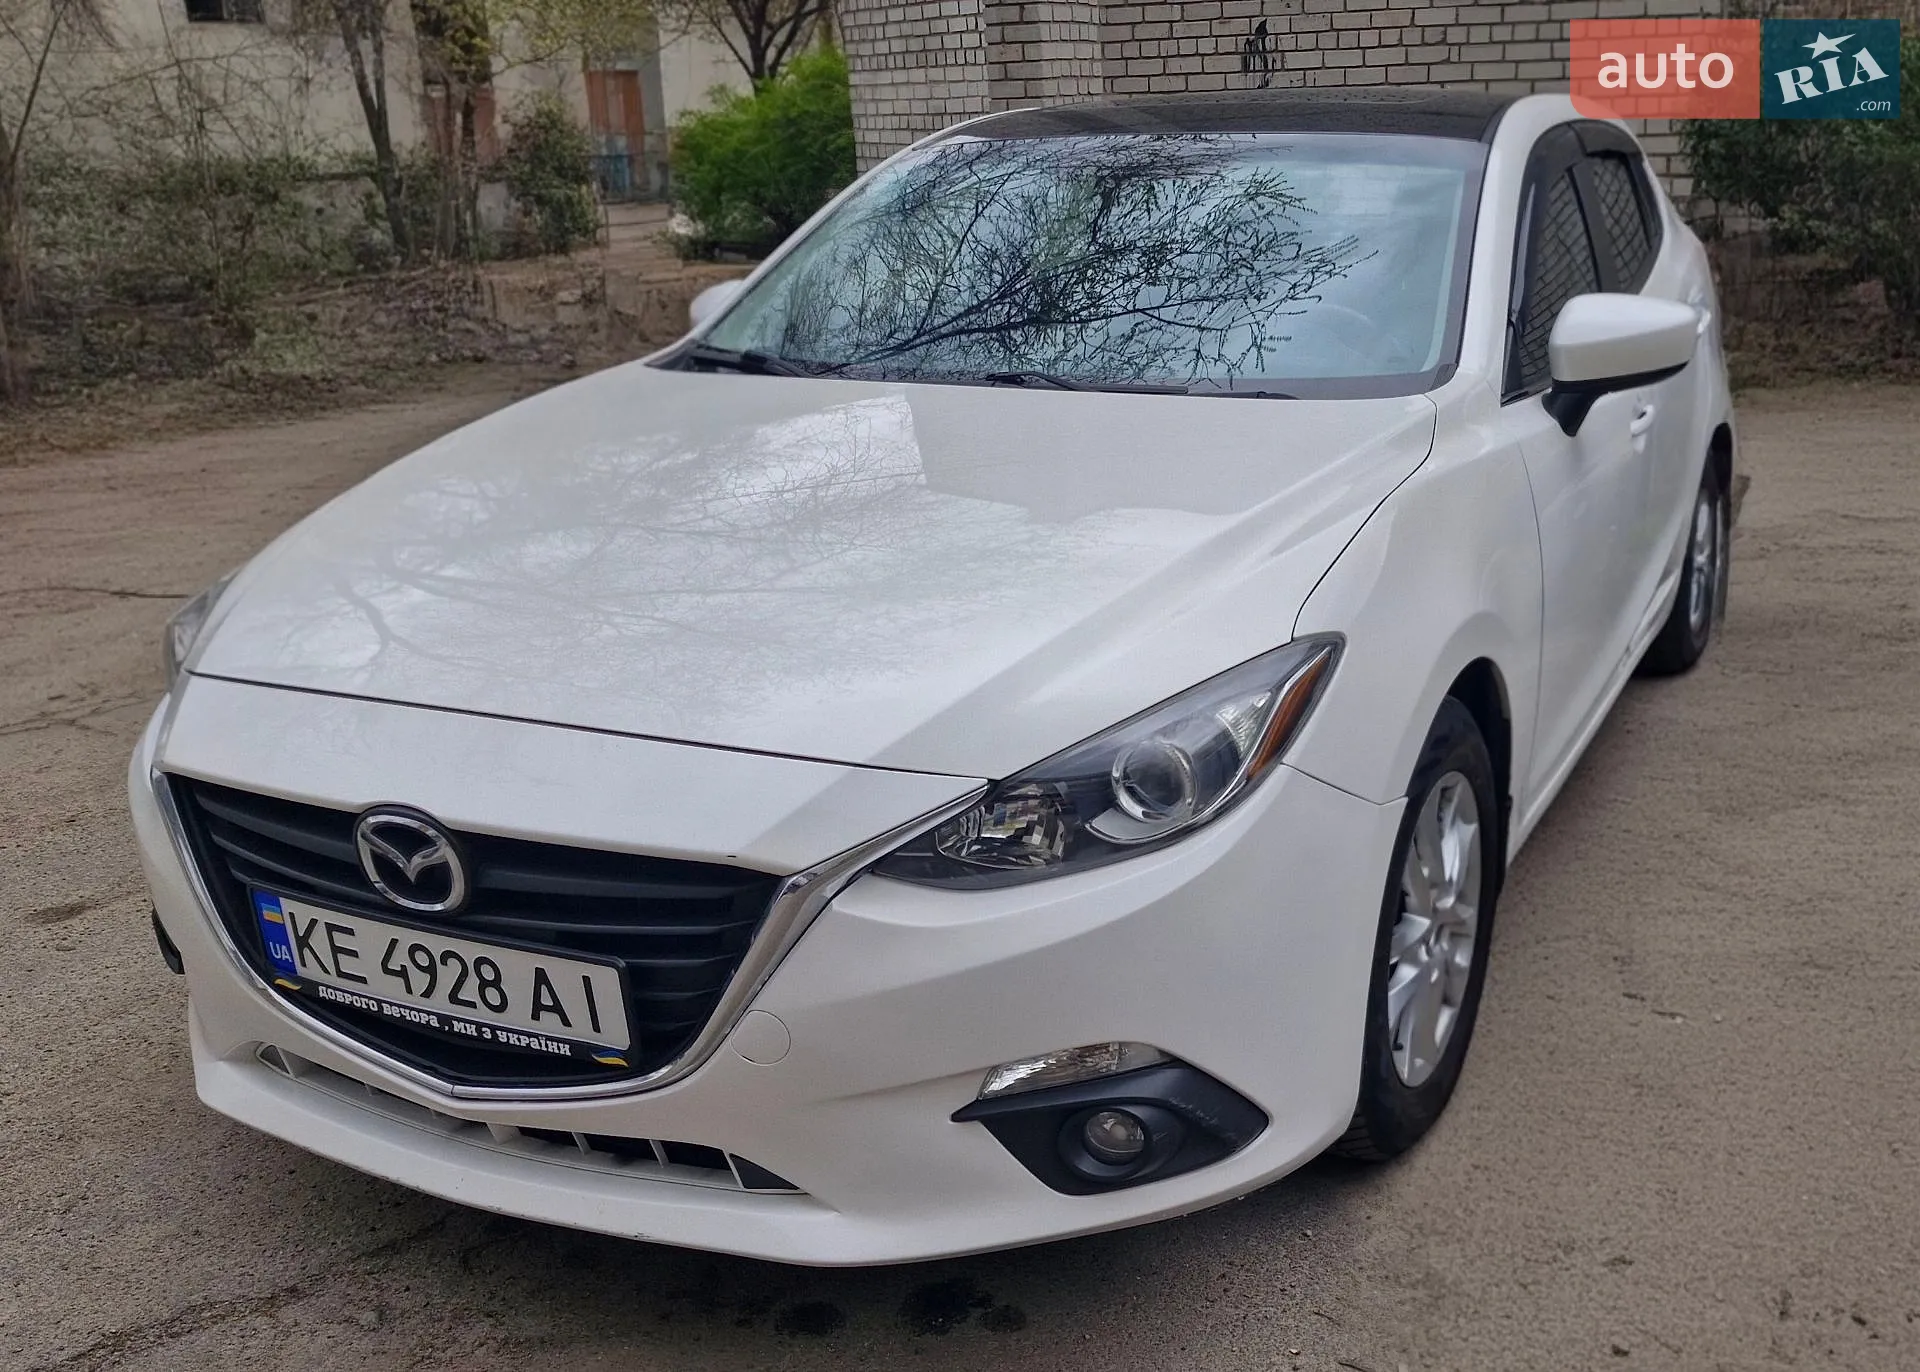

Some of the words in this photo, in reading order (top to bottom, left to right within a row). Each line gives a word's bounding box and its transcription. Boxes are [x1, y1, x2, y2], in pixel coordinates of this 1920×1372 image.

[269, 941, 293, 963] UA
[288, 911, 368, 985] KE
[380, 938, 509, 1014] 4928
